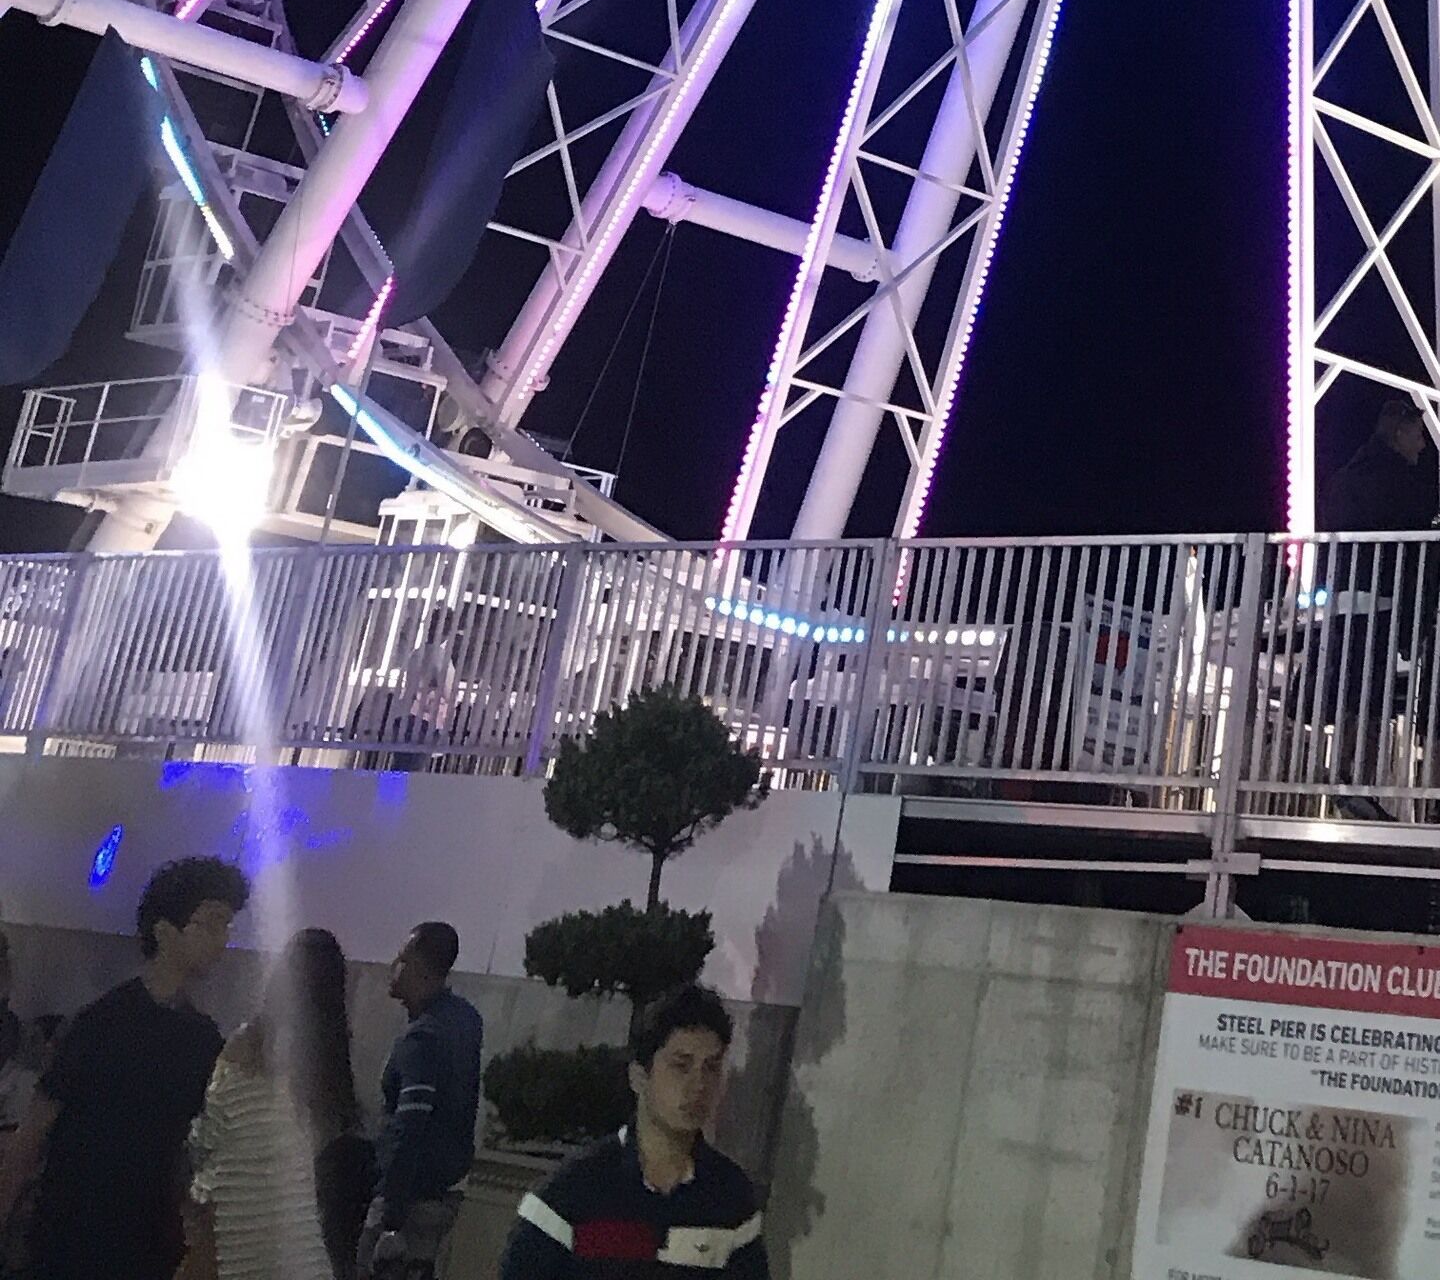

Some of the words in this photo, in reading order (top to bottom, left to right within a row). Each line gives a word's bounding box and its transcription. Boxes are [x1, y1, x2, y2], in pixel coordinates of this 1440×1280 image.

[1185, 948, 1229, 979] THE
[1232, 952, 1382, 993] FOUNDATION
[1217, 1013, 1265, 1035] STEEL
[1270, 1019, 1305, 1040] PIER
[1310, 1023, 1327, 1042] IS
[1199, 1034, 1236, 1054] MAKE
[1240, 1038, 1278, 1058] SURE
[1283, 1043, 1300, 1061] TO
[1304, 1045, 1322, 1063] BE
[1325, 1048, 1334, 1064] A
[1339, 1049, 1375, 1069] PART
[1380, 1053, 1400, 1071] OF
[1215, 1102, 1302, 1139] CHUCK
[1305, 1112, 1324, 1141] &
[1333, 1116, 1396, 1149] NINA
[1233, 1136, 1369, 1177] CATANOSO
[1265, 1173, 1330, 1205] 6-1-17
